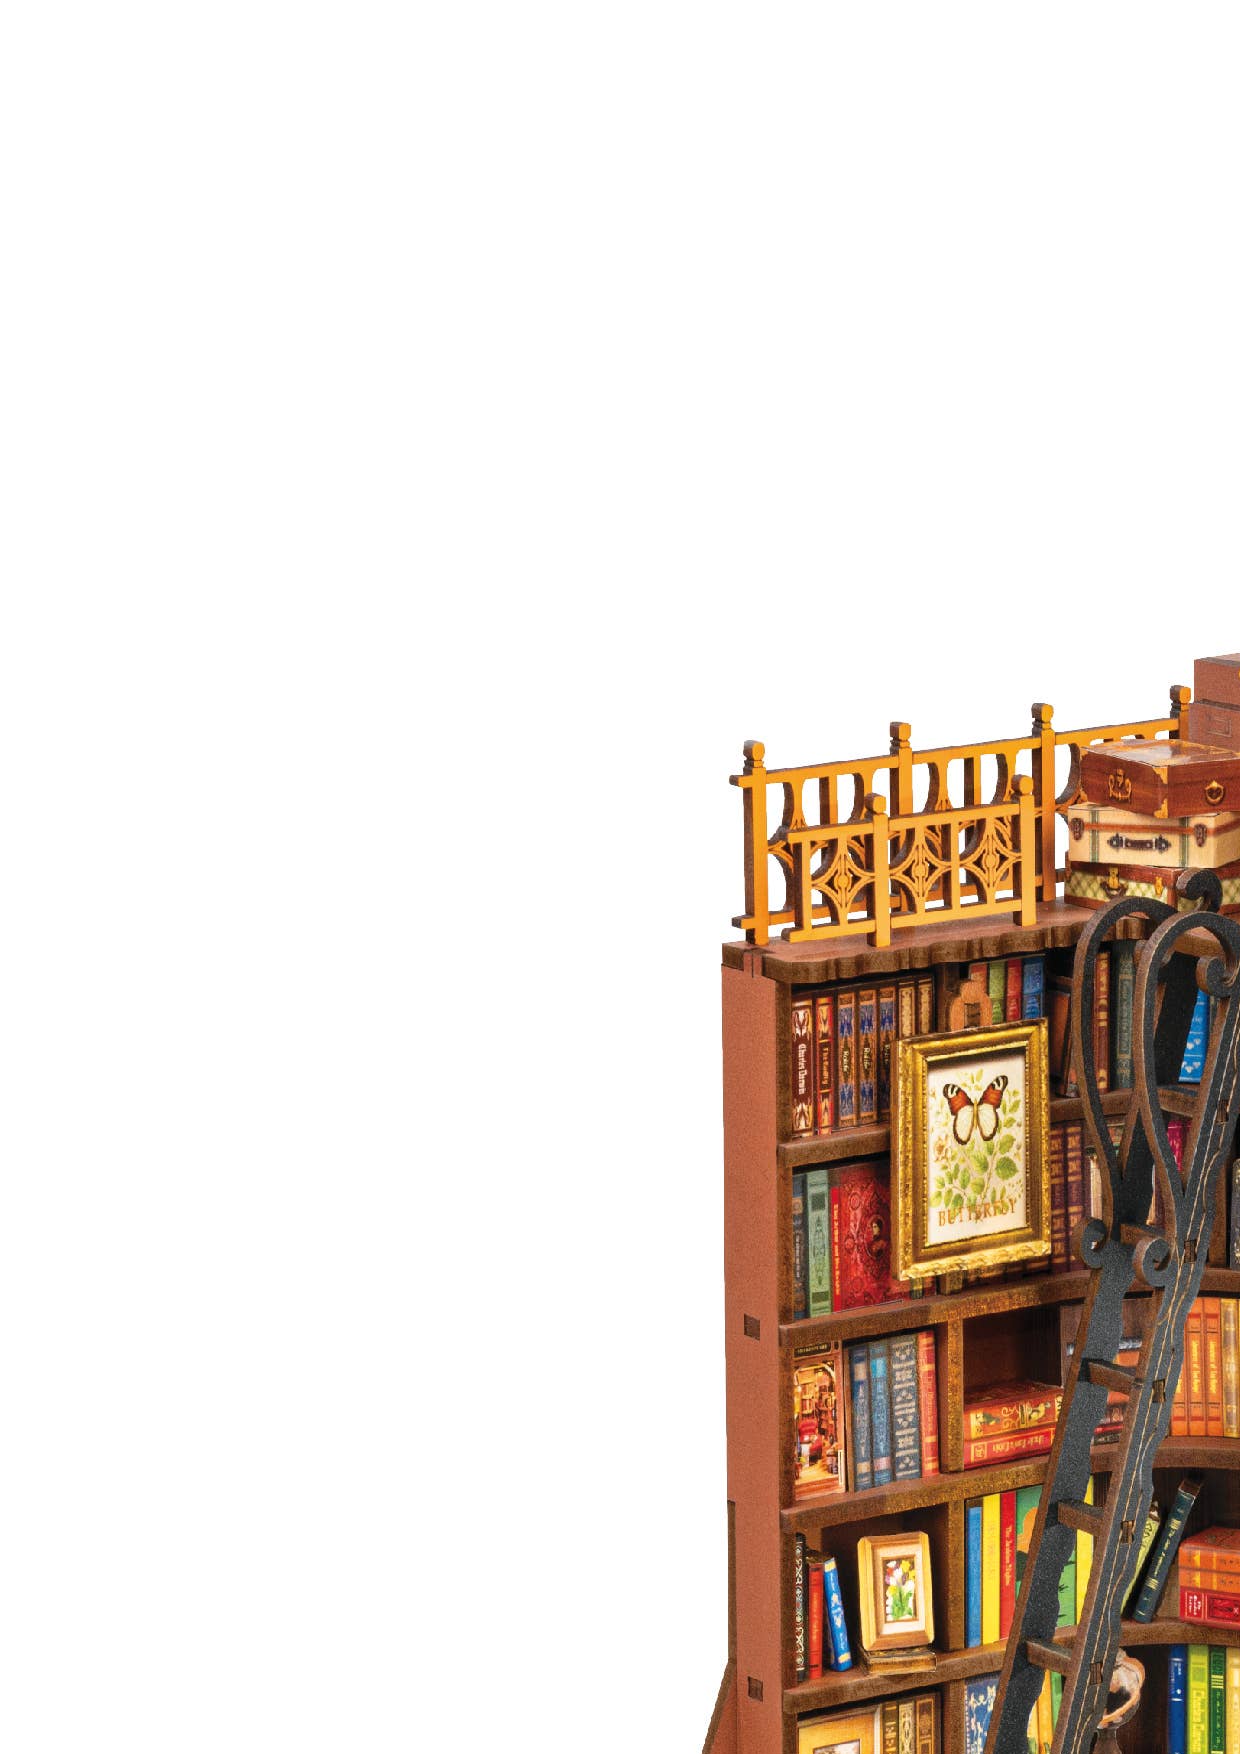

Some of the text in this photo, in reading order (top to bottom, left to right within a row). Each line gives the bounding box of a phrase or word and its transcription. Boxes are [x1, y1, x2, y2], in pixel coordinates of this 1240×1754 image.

[798, 1043, 808, 1095] Charles Darwin
[938, 1198, 1017, 1227] BUTTERFLY
